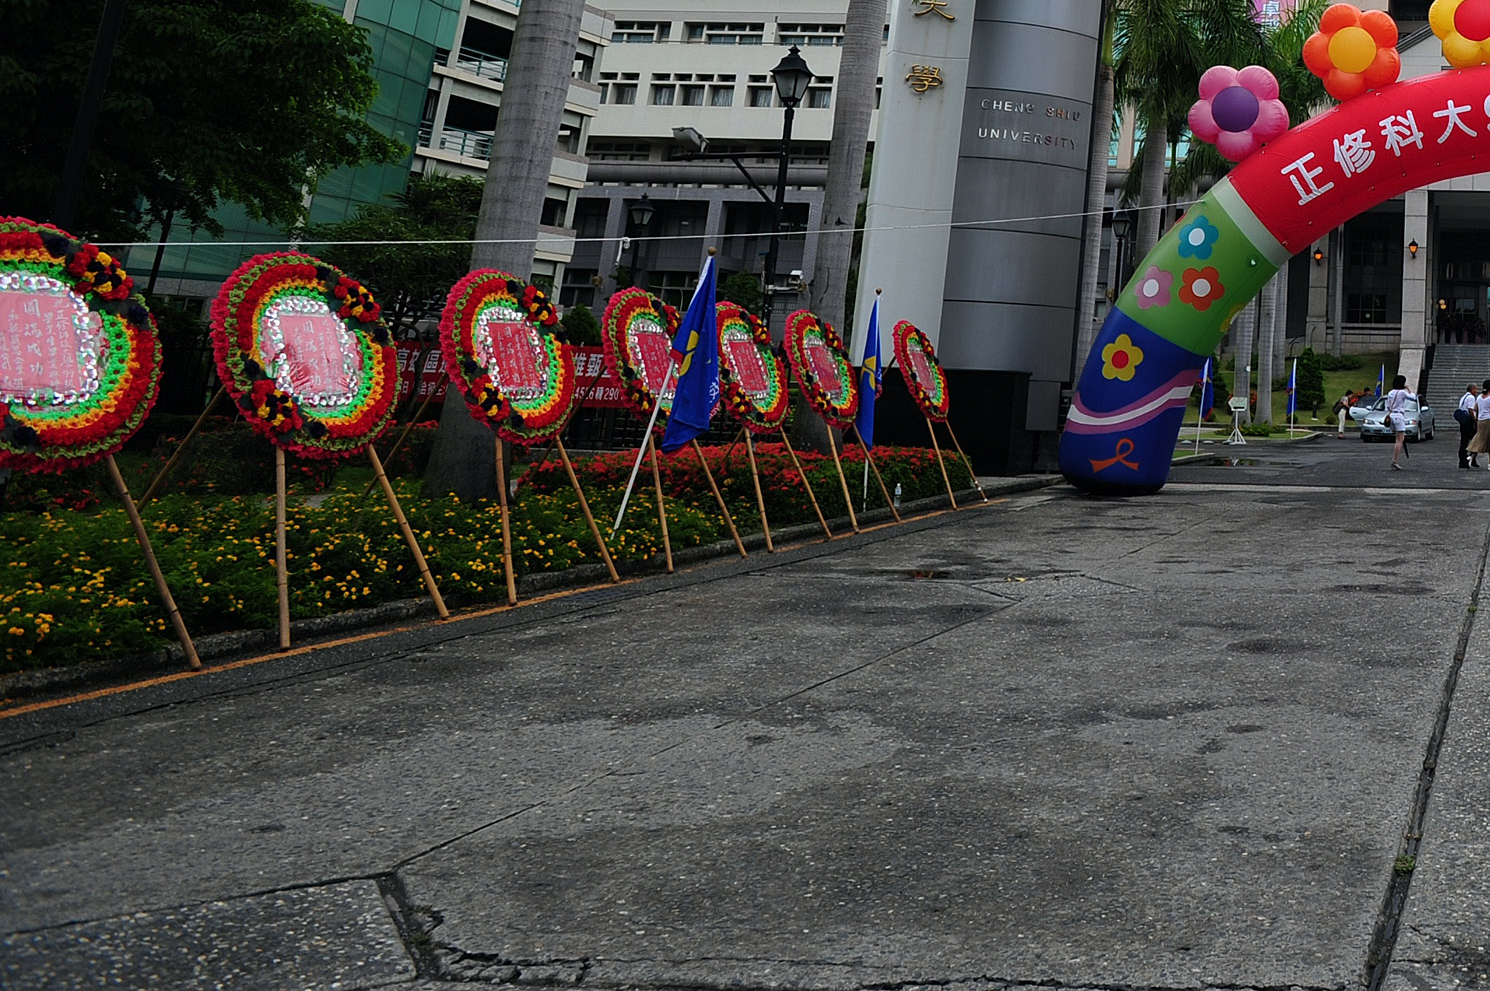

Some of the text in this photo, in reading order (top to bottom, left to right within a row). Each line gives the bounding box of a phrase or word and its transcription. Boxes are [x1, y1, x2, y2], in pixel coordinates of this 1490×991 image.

[981, 98, 1081, 121] CHENG SHIU
[978, 127, 1077, 151] UNIVERSITY
